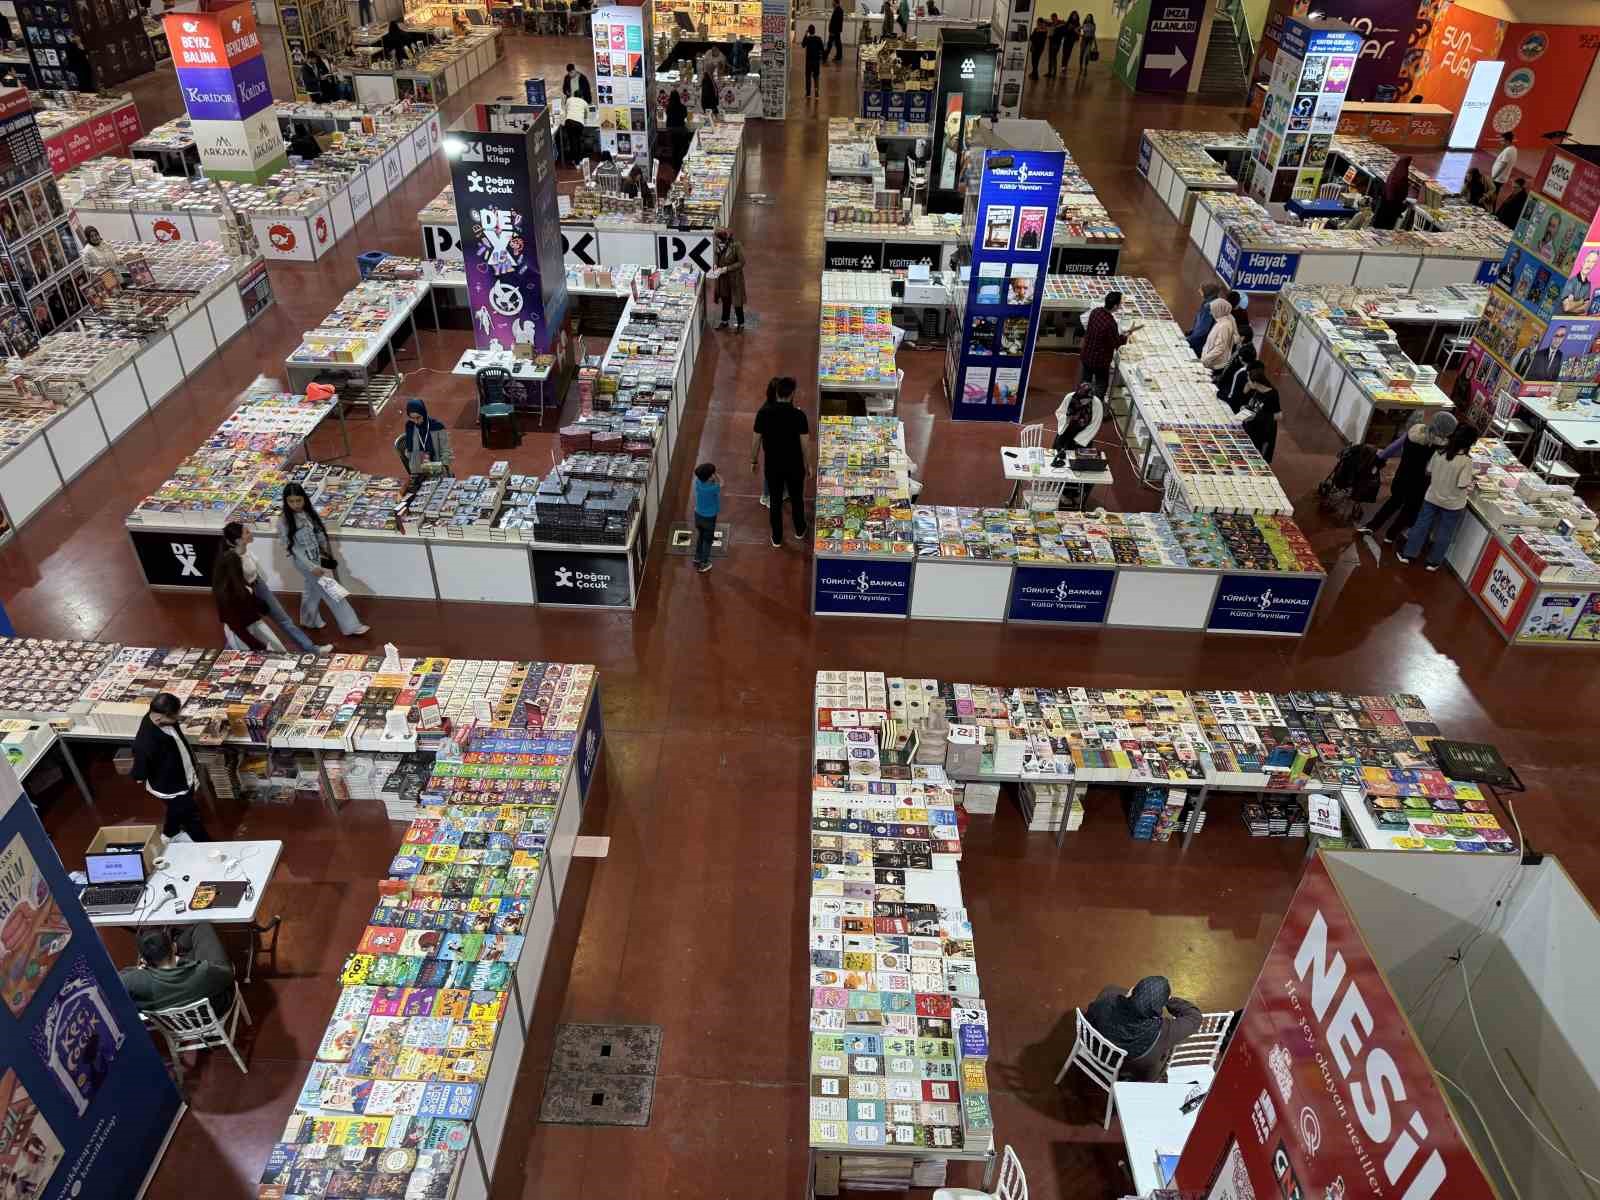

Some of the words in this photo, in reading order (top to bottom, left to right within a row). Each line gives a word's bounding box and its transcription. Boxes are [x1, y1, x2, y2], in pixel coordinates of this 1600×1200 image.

[1152, 21, 1195, 30] ALANLARI
[181, 36, 211, 48] BEYAZ
[184, 51, 217, 64] BALİNA
[204, 146, 248, 157] ARKADYA
[486, 144, 514, 154] Doğan
[487, 154, 510, 165] Kitap
[485, 176, 514, 186] Doğan
[486, 186, 513, 194] Çocuk
[1249, 254, 1288, 271] Hayat
[576, 572, 610, 582] Doğan
[576, 580, 608, 590] Çocuk
[1022, 586, 1056, 594] TÜRKİYE
[858, 594, 890, 602] Yayınları
[1222, 594, 1259, 602] TÜRKİYE
[1272, 598, 1310, 606] BANKASI
[1056, 602, 1086, 610] Yayınları
[1230, 610, 1255, 618] Kültür
[1256, 612, 1290, 620] Yayınları
[1284, 978, 1301, 1012] Her
[1315, 1051, 1348, 1118] okuyan
[1345, 1120, 1384, 1197] nesiller
